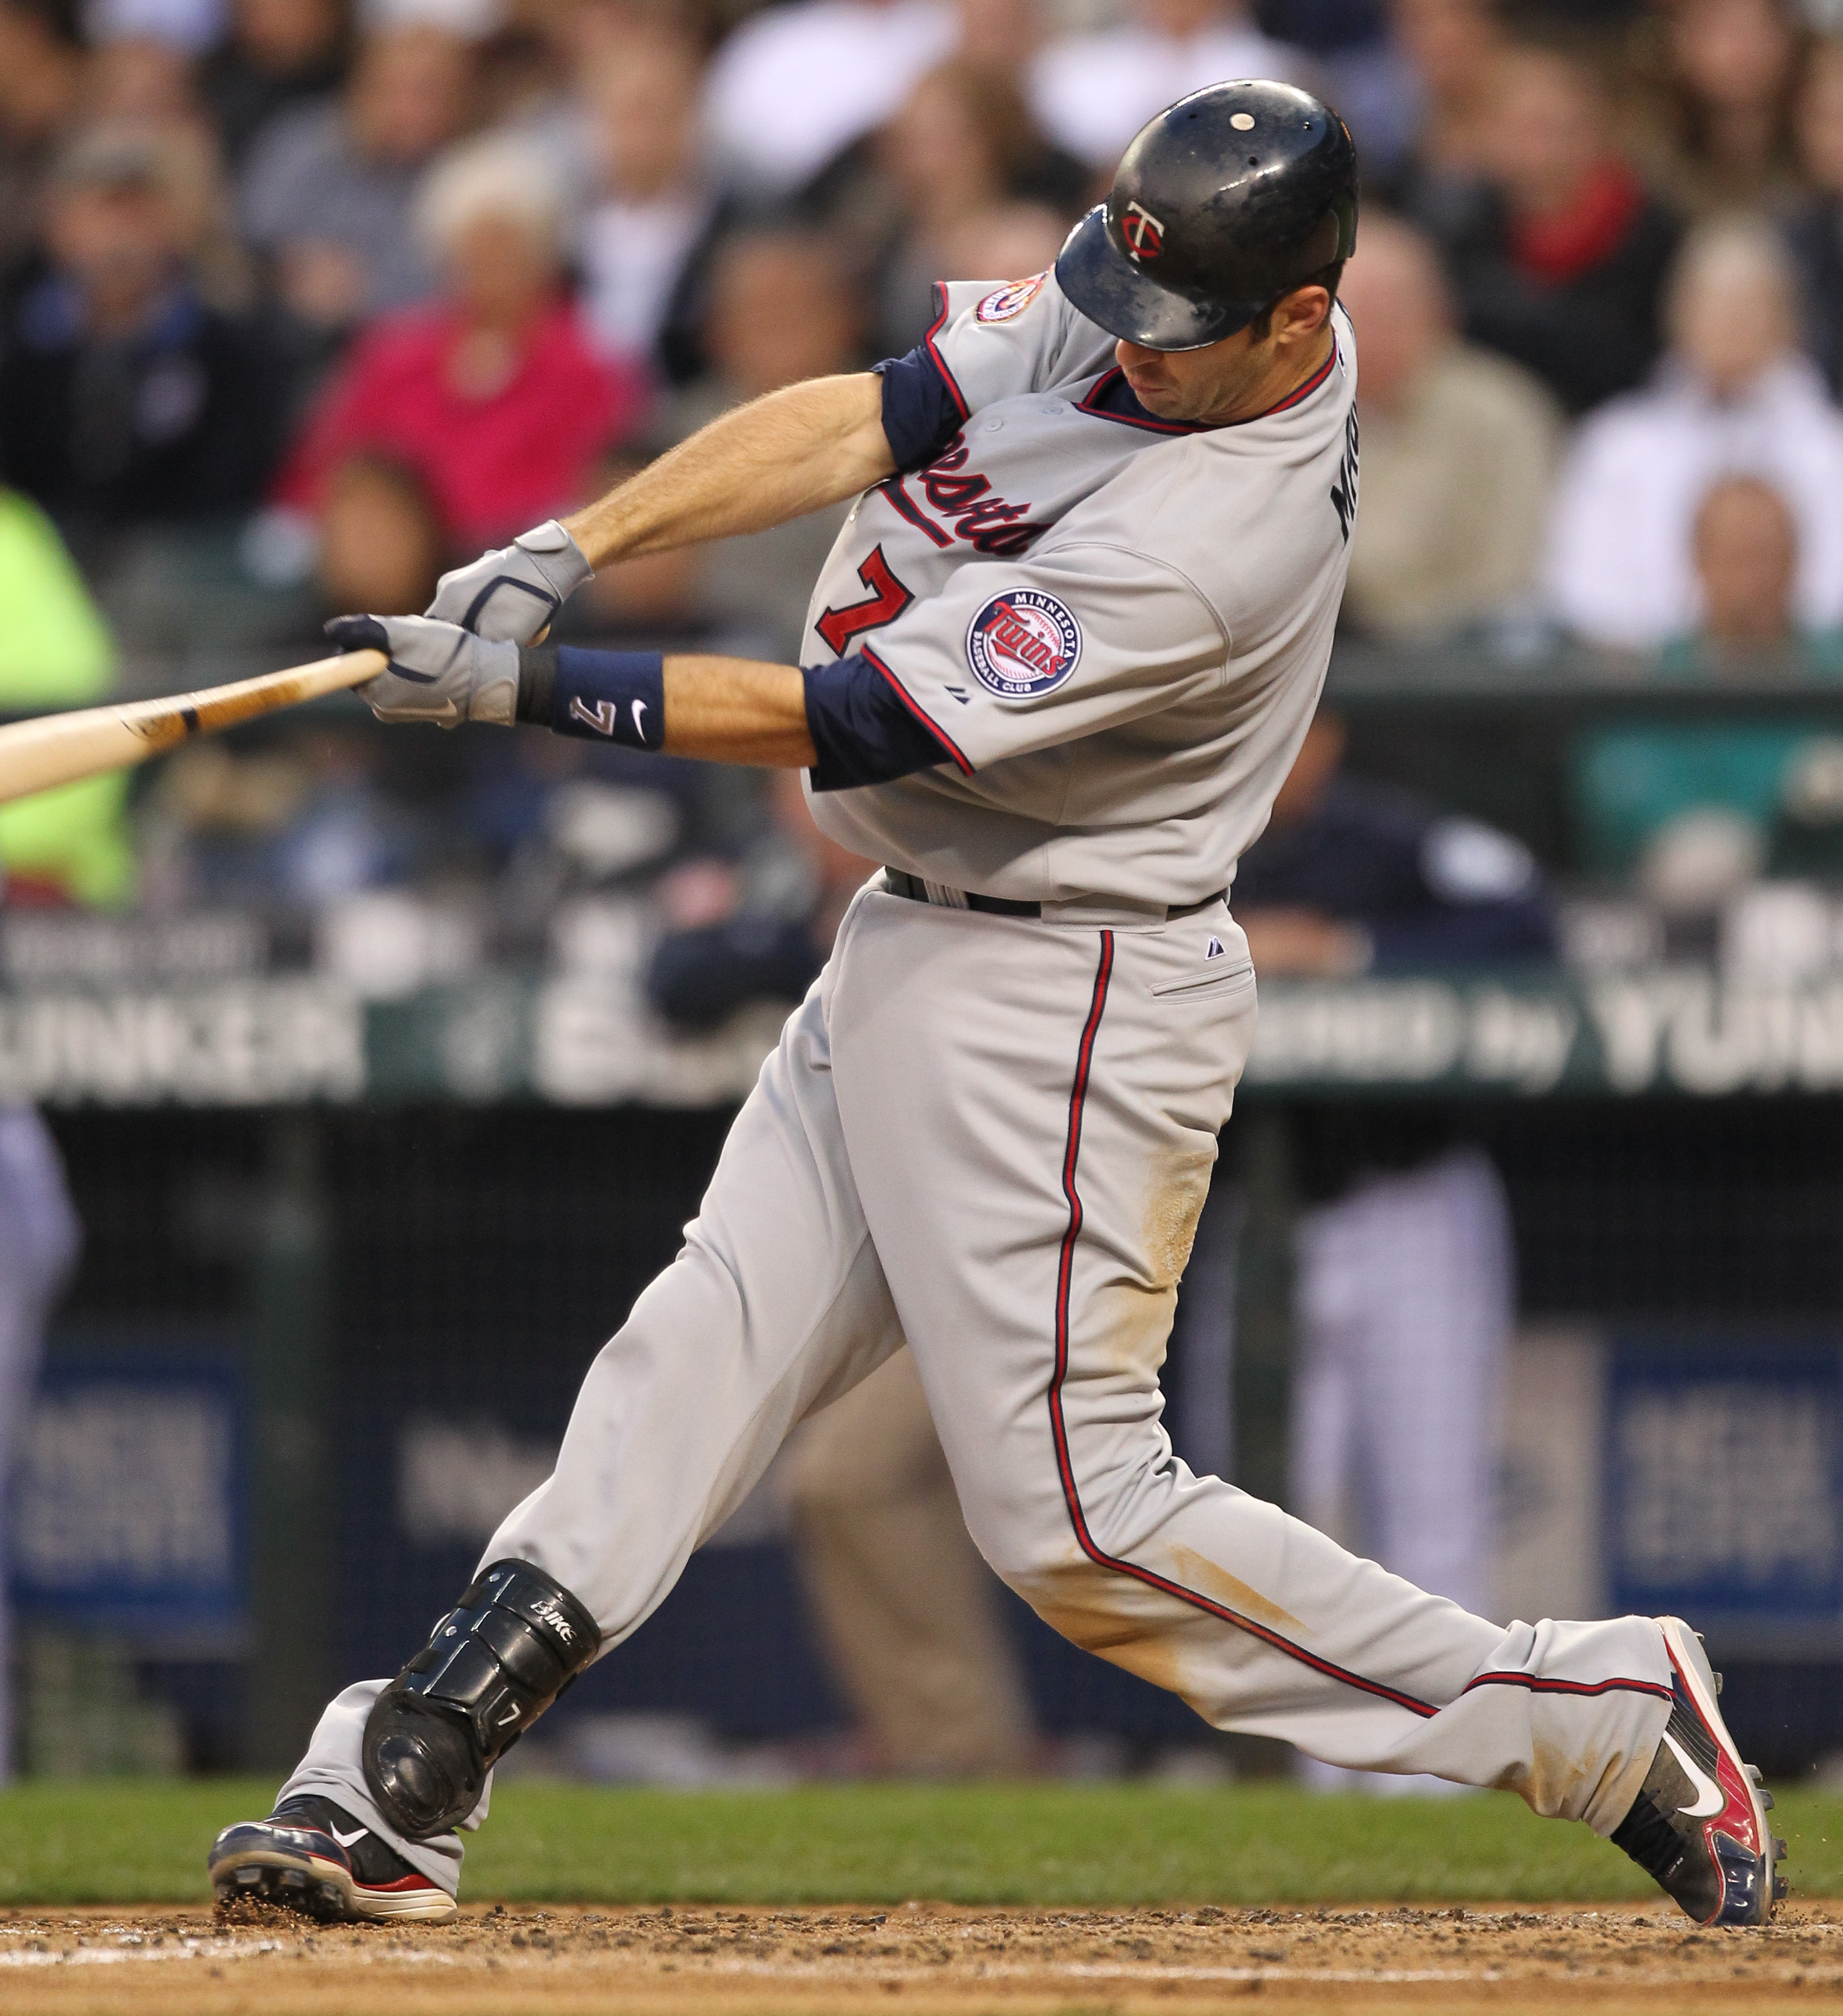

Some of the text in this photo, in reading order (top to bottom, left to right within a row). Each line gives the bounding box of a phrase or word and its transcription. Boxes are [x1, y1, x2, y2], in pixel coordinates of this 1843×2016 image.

[814, 542, 915, 658] 7
[1015, 593, 1076, 659] MINNESOTA
[973, 631, 999, 687] BASEBALL
[983, 600, 1068, 679] Twins
[1002, 682, 1033, 692] CLUB
[569, 695, 616, 737] 7
[498, 1702, 521, 1727] 7
